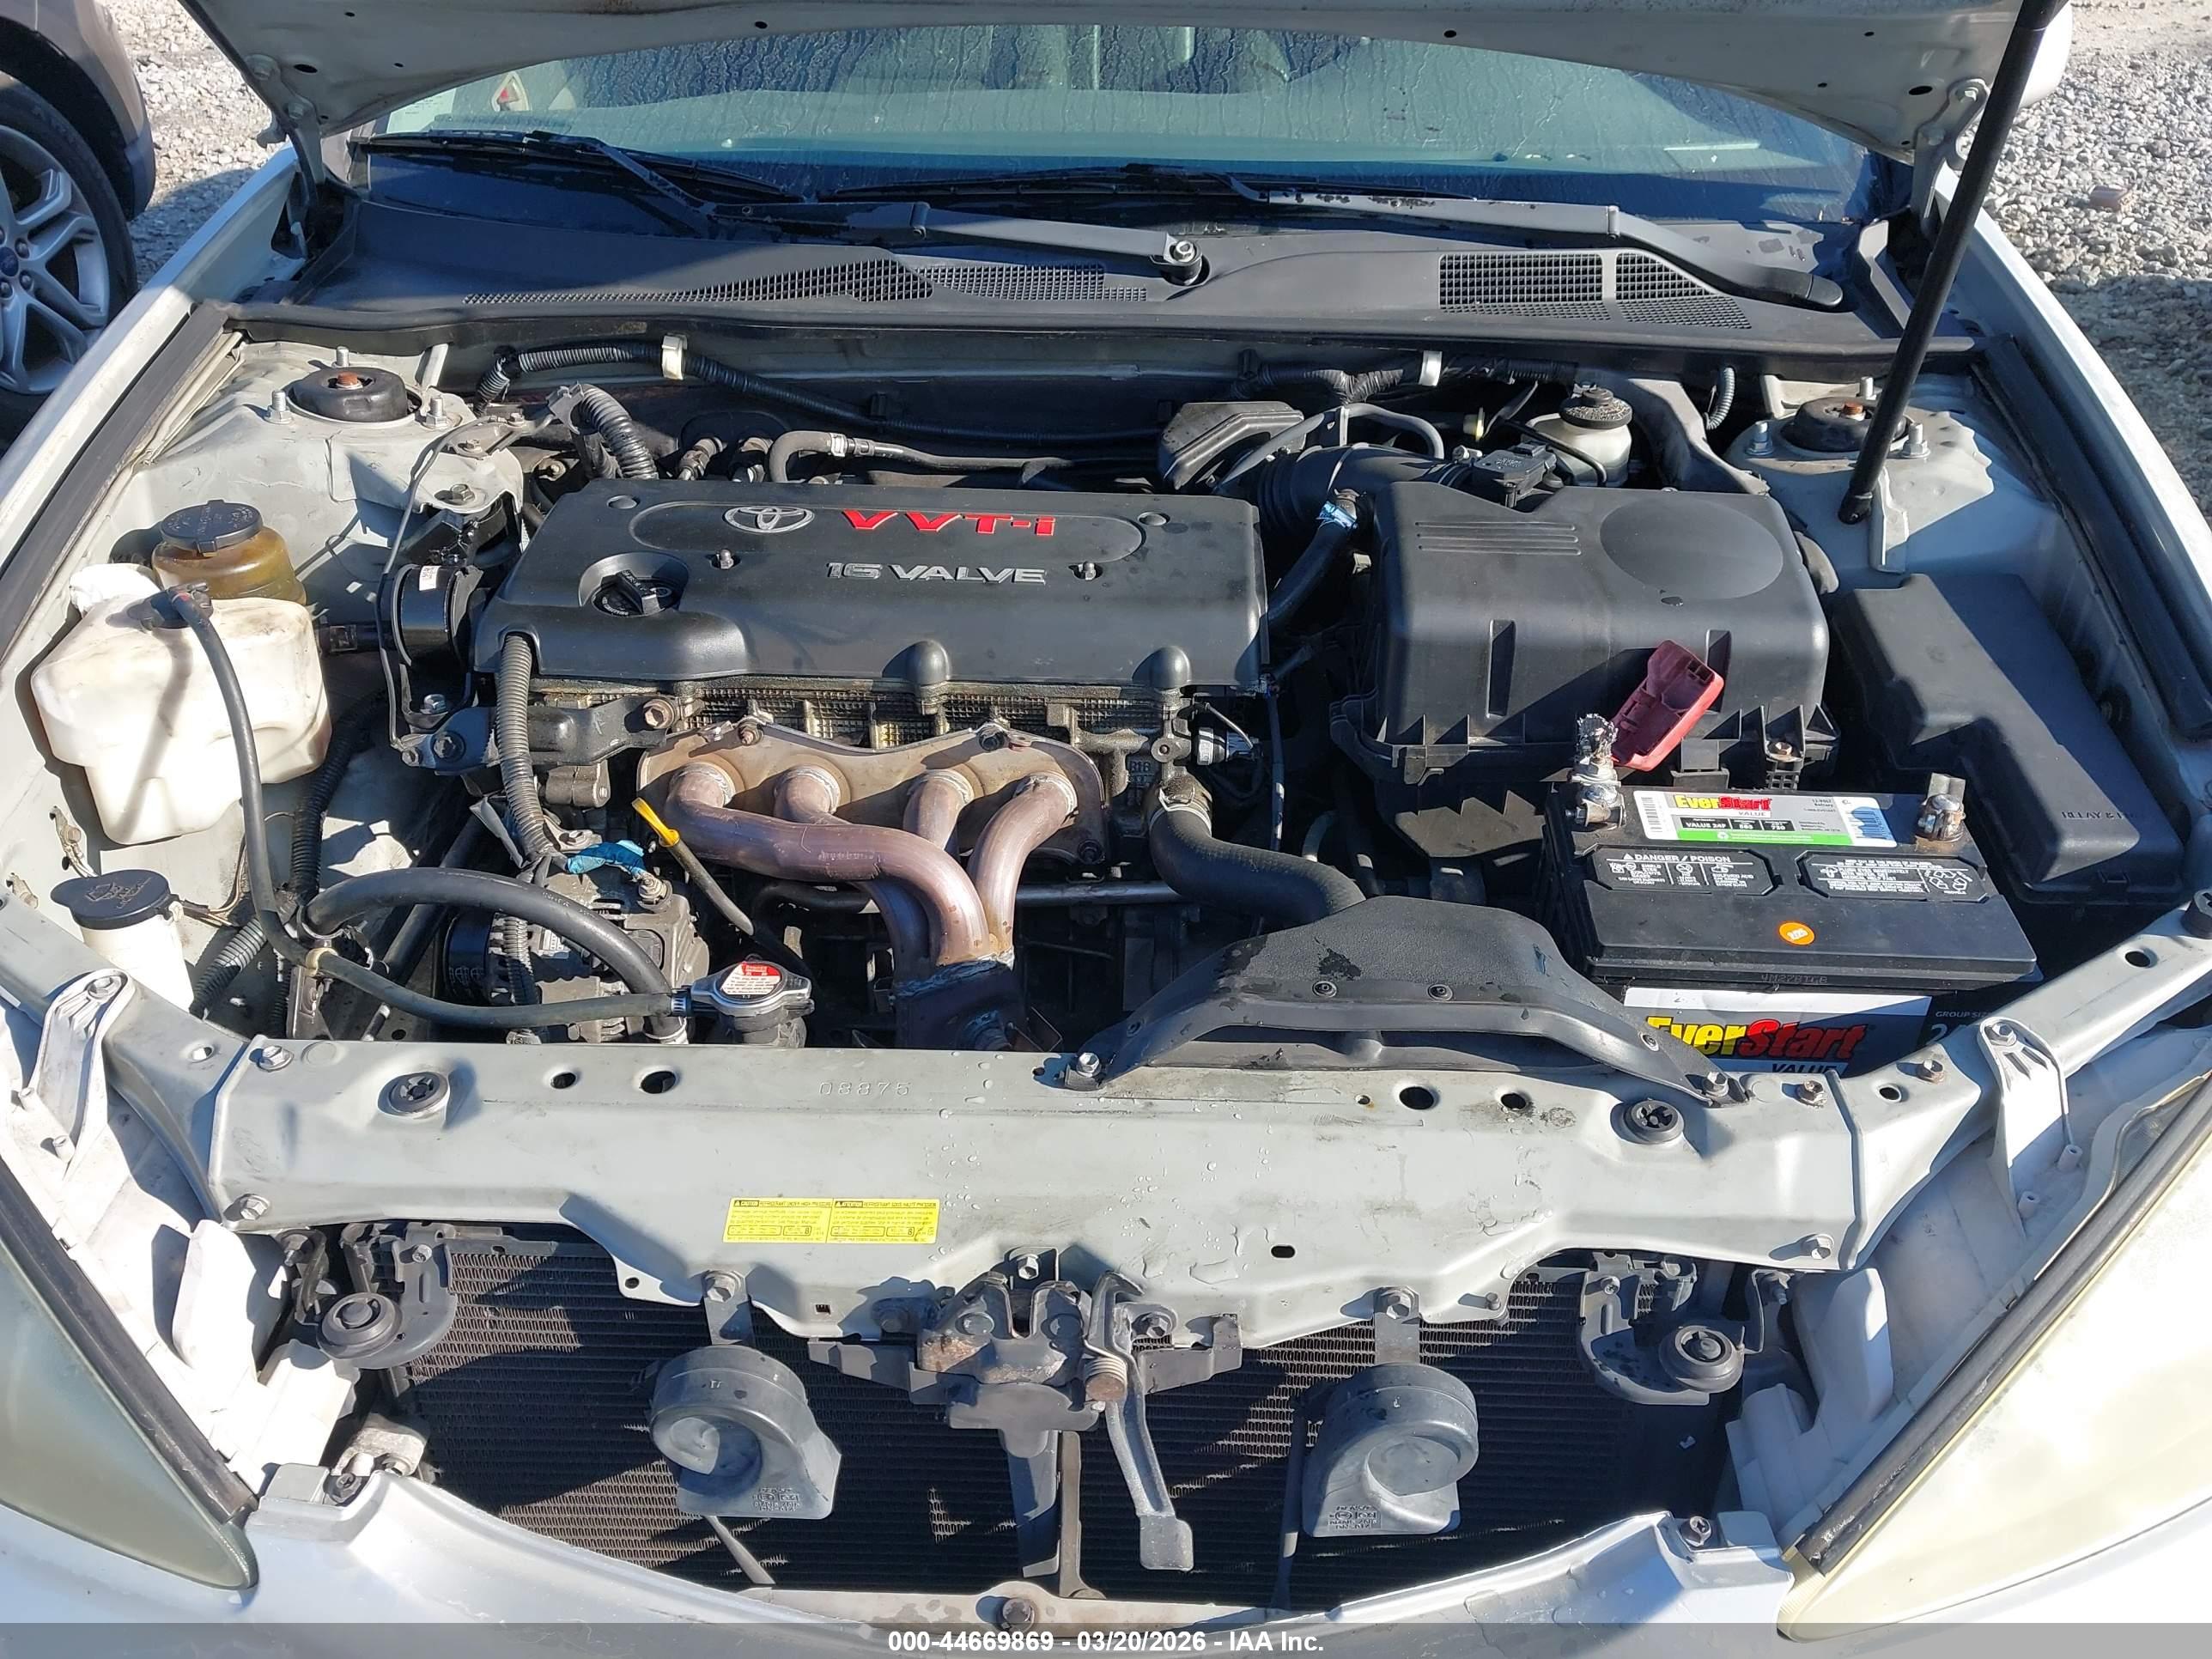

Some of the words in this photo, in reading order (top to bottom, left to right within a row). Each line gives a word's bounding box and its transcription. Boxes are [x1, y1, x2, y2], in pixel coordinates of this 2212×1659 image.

[827, 561, 884, 580] 16
[887, 563, 1047, 586] VALVE
[1674, 794, 1771, 811] EverStart
